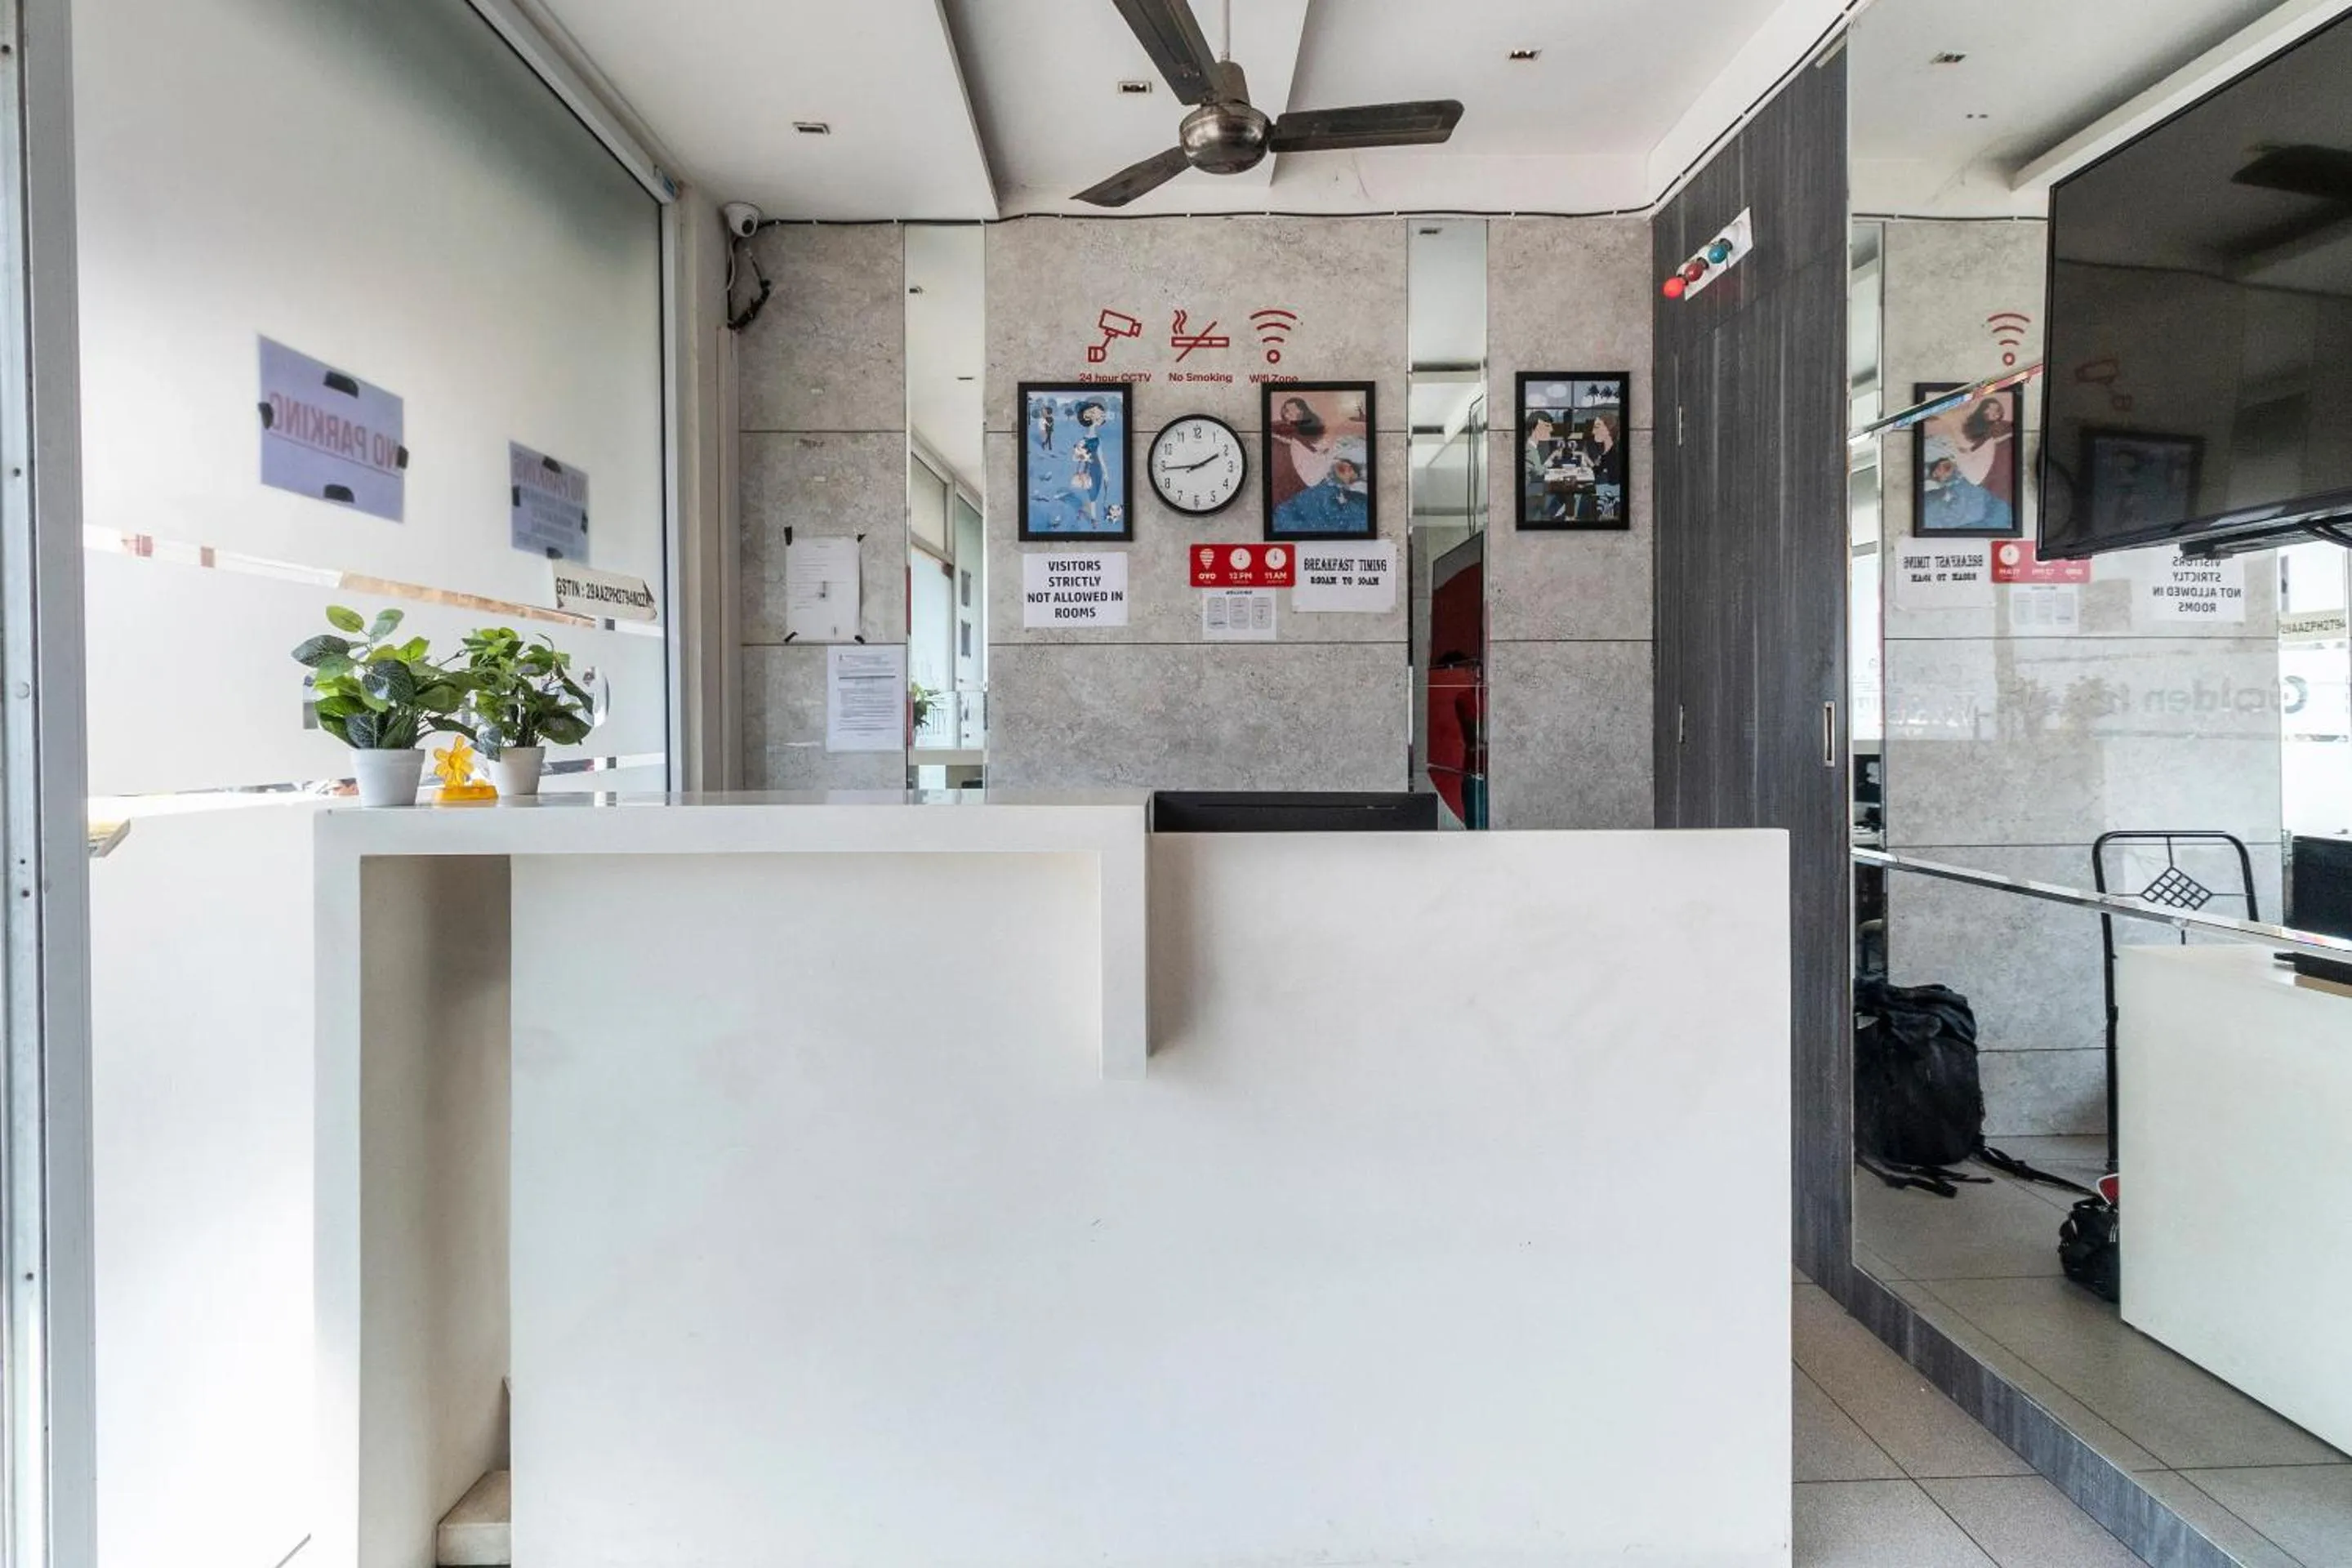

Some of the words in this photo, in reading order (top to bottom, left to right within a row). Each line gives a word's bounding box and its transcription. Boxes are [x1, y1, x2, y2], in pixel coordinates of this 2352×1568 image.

[1080, 372, 1093, 382] 24
[1095, 372, 1118, 383] hour
[1121, 373, 1152, 382] CCTV
[1169, 372, 1183, 381] No
[1186, 372, 1233, 384] Smoking
[1250, 374, 1272, 383] Wifi
[1272, 374, 1298, 383] Zone
[1049, 560, 1101, 572] VISITORS
[1304, 558, 1354, 571] BREAKFAST
[1357, 559, 1387, 572] TIMING
[1049, 576, 1101, 587] STRICTLY
[1342, 576, 1352, 586] TO
[556, 577, 581, 598] GSTIN
[1027, 592, 1051, 603] NOT
[1054, 591, 1107, 603] ALLOWED
[1111, 590, 1124, 601] IN
[1054, 608, 1096, 618] ROOMS
